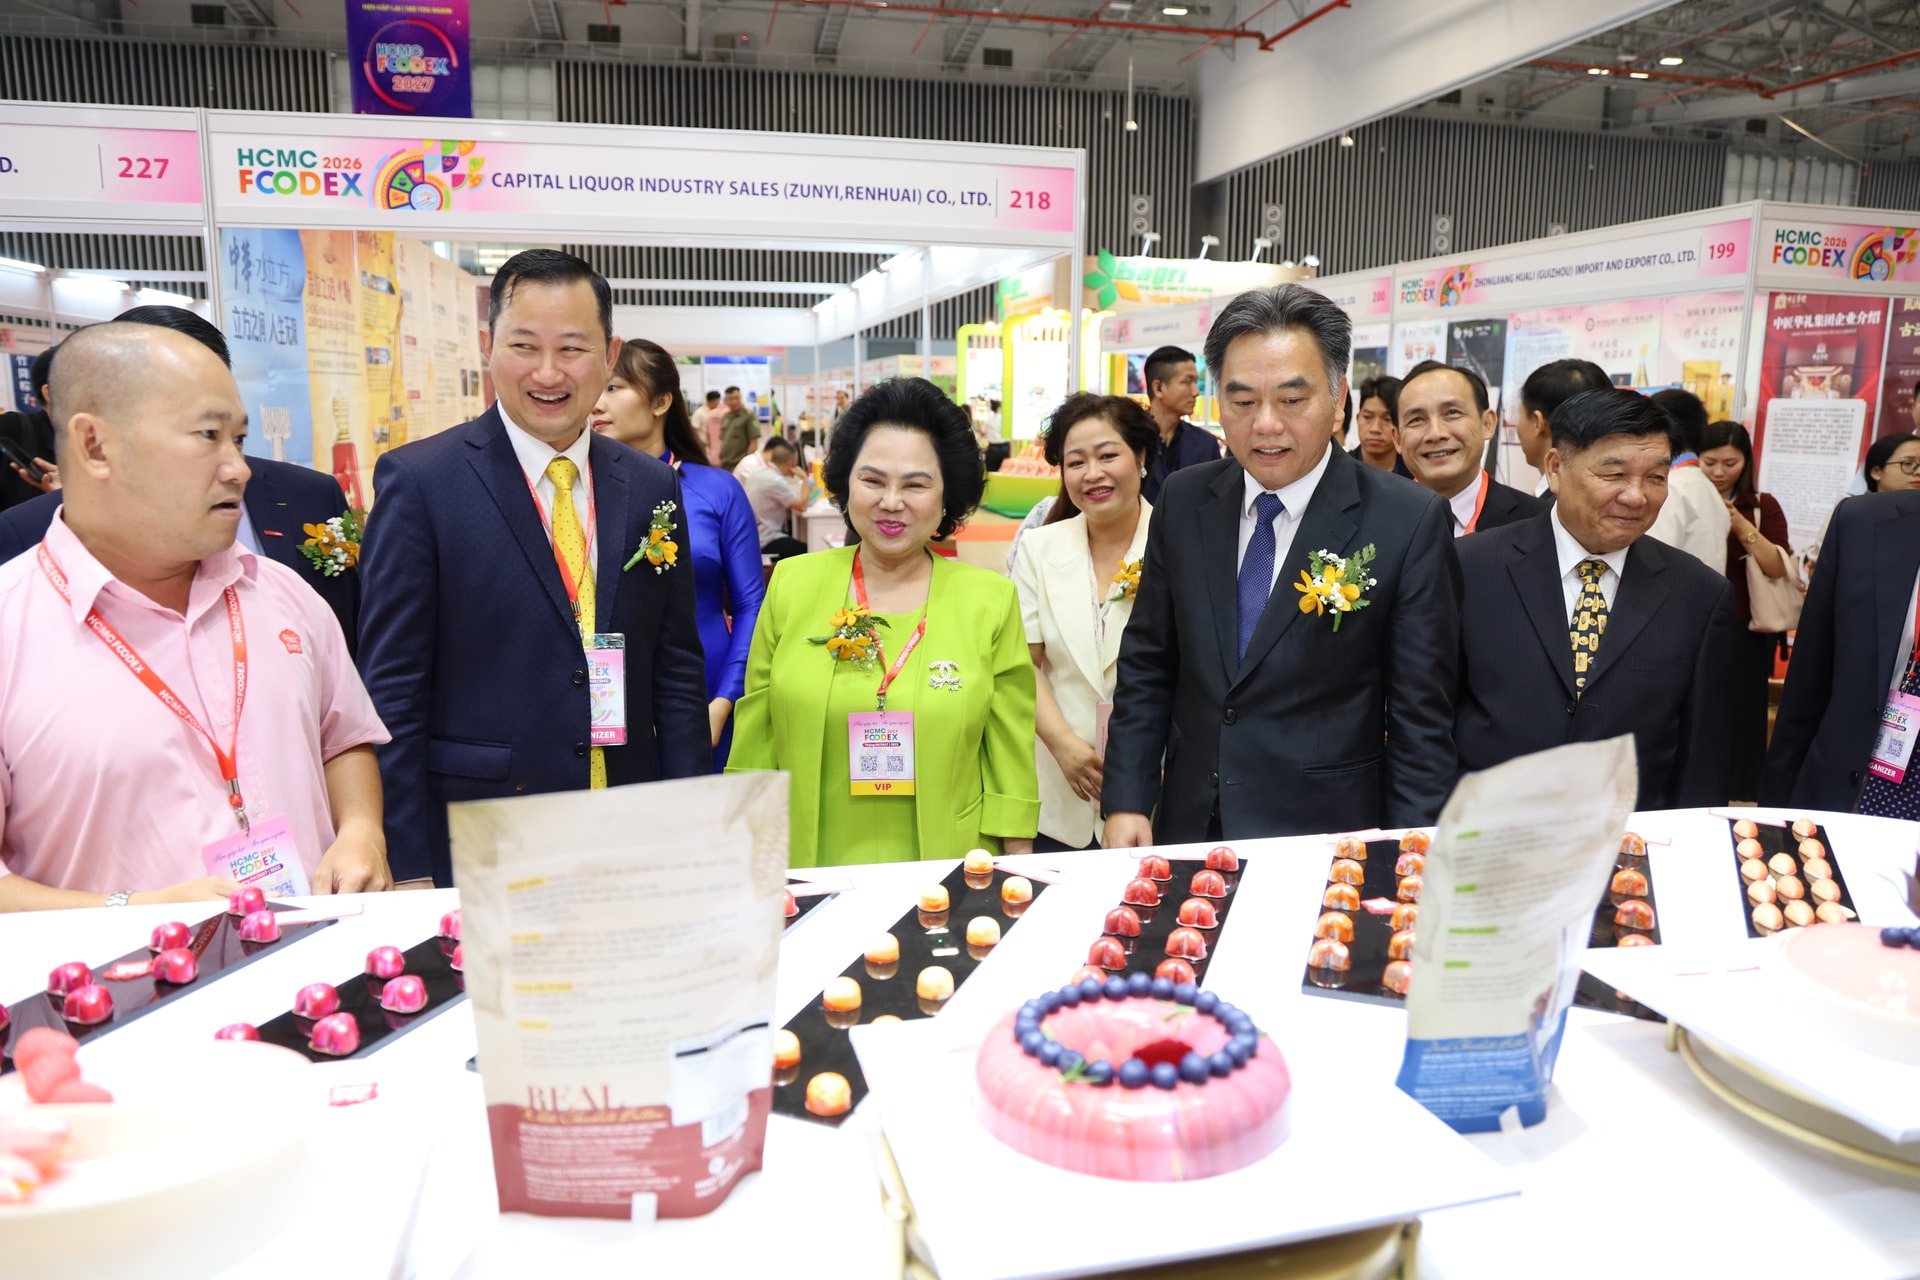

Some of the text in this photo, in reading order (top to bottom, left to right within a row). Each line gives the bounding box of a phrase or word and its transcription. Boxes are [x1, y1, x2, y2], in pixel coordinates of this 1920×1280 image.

[376, 43, 424, 57] HCMC
[392, 75, 435, 93] 2027
[118, 157, 169, 179] 227
[237, 148, 363, 170] HCMC 2026
[491, 172, 1051, 210] CAPITAL LIQUOR INDUSTRY SALES (ZUNYI,RENHUAI) CO., LTD. 218
[1775, 229, 1848, 248] HCMC 2026
[1575, 261, 1604, 275] IMPORT
[1605, 259, 1624, 272] AND
[1624, 254, 1657, 269] EXPORT
[1658, 253, 1675, 266] CO.,
[1677, 249, 1697, 263] LTD.
[1709, 242, 1735, 260] 199
[1402, 278, 1424, 290] HCMC
[1372, 291, 1386, 303] 200
[88, 614, 115, 643] HCMC
[233, 615, 243, 643] HCMC
[159, 689, 186, 717] HCMC
[1885, 706, 1899, 715] CMC
[591, 731, 616, 739] NIZER
[1869, 762, 1897, 778] GANIZER
[874, 783, 892, 791] VIP
[229, 851, 260, 869] HCMC
[527, 1084, 625, 1112] REAL
